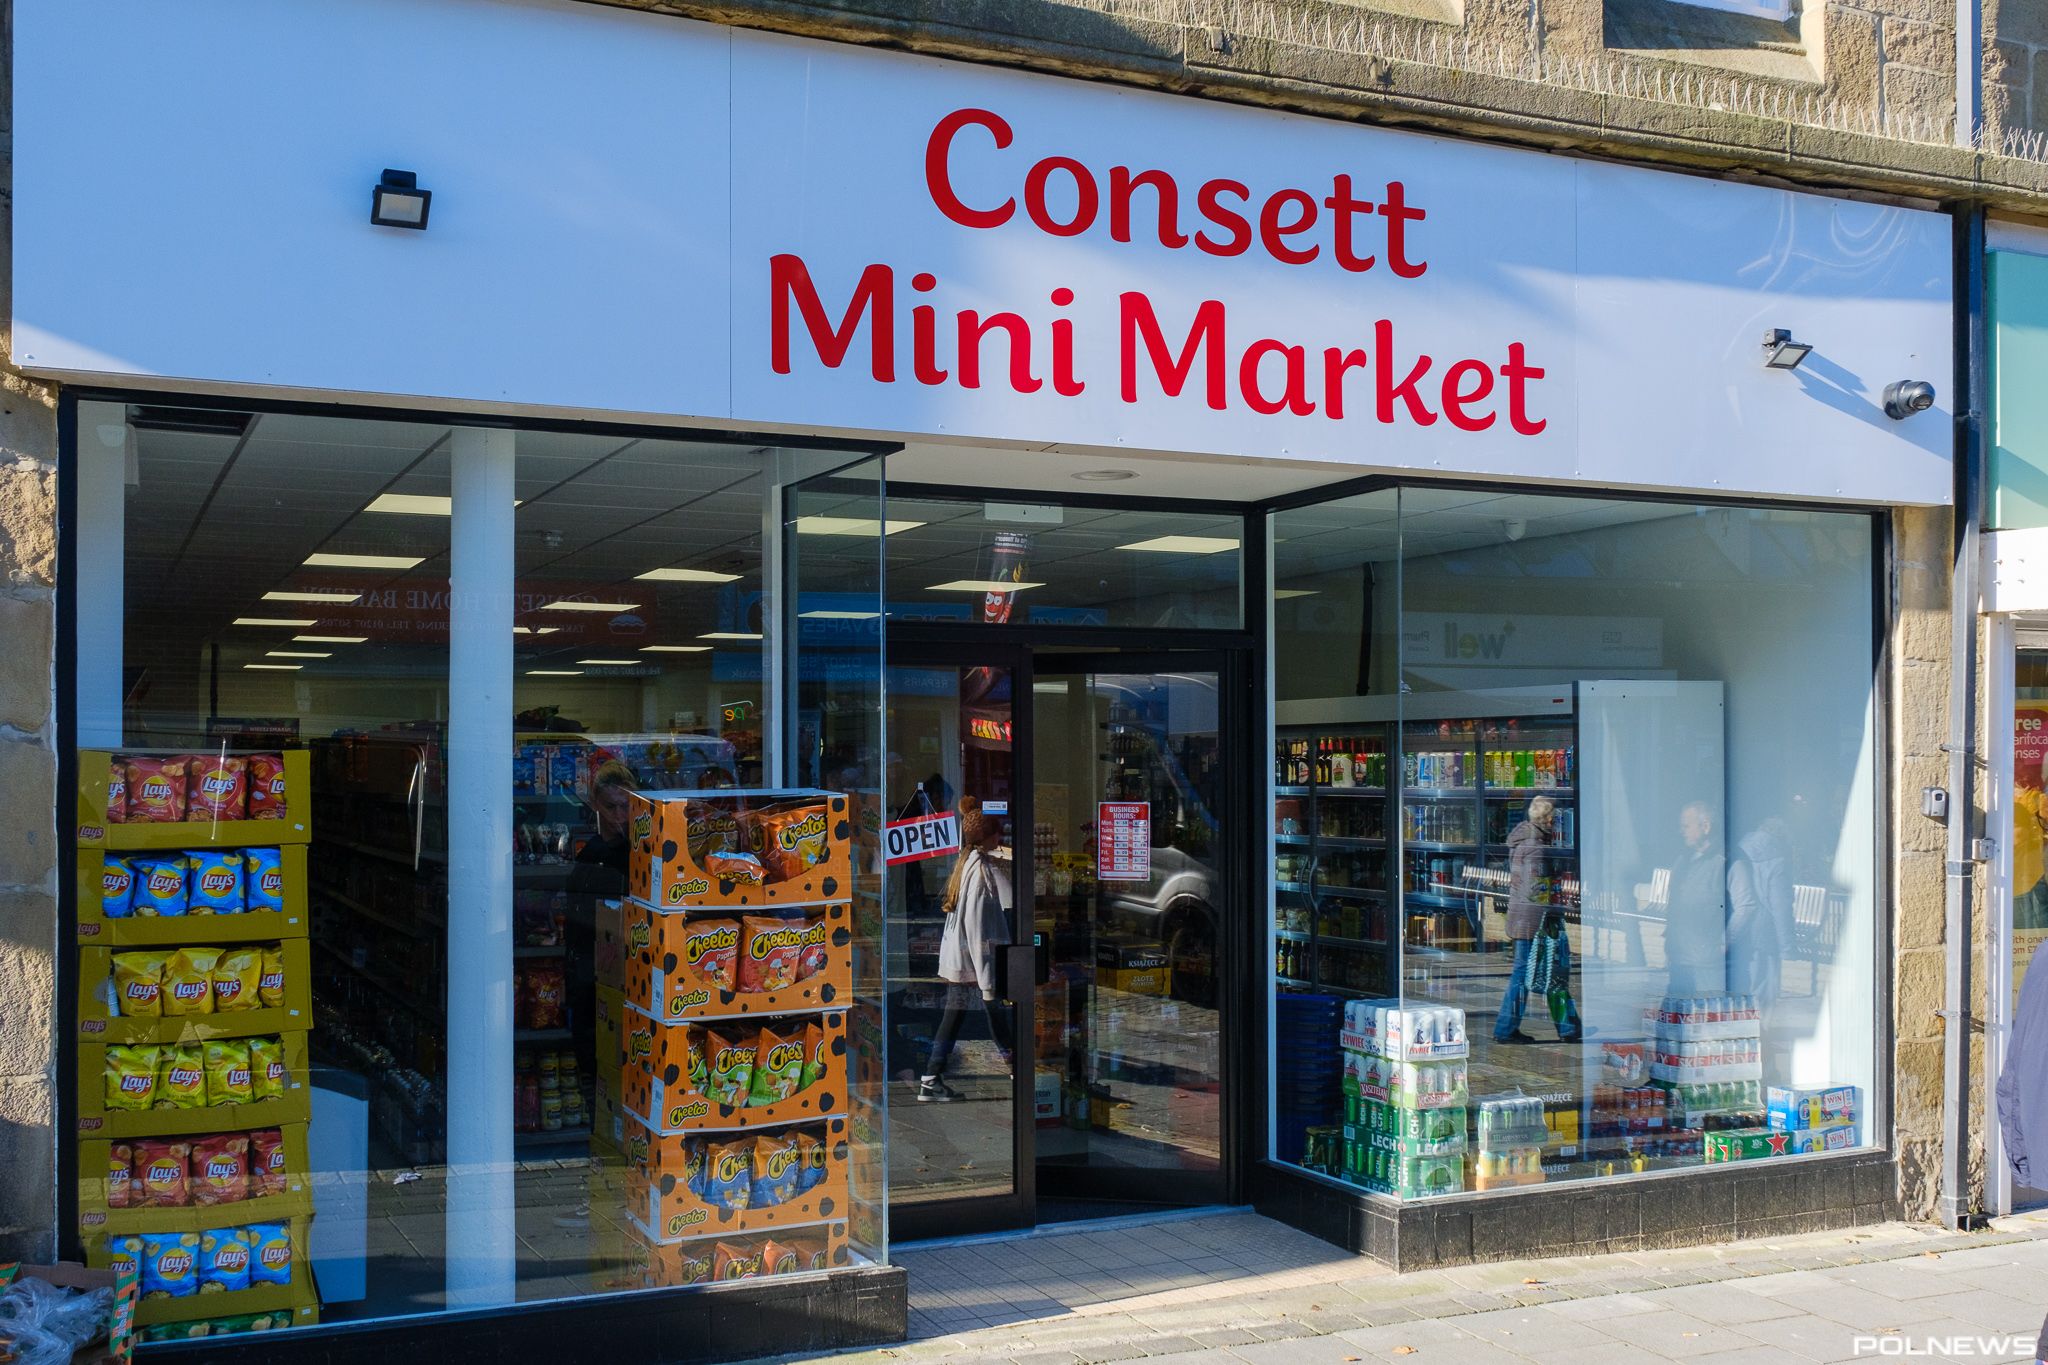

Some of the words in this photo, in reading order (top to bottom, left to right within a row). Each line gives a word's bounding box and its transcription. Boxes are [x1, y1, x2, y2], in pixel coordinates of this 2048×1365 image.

[925, 108, 1428, 279] Consett
[769, 253, 1085, 397] Mini
[1120, 291, 1547, 436] Market
[2015, 716, 2042, 731] ree
[2015, 748, 2041, 759] nses
[143, 783, 173, 799] Lay's
[203, 777, 236, 795] Lay's
[79, 826, 103, 839] Lay's
[779, 815, 827, 851] Cheetos
[887, 820, 951, 856] OPEN
[103, 874, 129, 891] ay's
[149, 874, 181, 892] Lay's
[202, 874, 234, 890] Lay's
[669, 880, 709, 903] Cheetos
[686, 928, 738, 964] Cheetos
[752, 928, 800, 960] Cheetos
[2013, 936, 2025, 945] ith
[127, 981, 159, 999] Lay's
[175, 981, 206, 999] Lay's
[670, 991, 710, 1015] Cheetos
[81, 1019, 106, 1033] Lay's
[169, 1067, 200, 1086] Lay's
[229, 1069, 250, 1086] Lay
[1826, 1094, 1842, 1104] WIN
[669, 1102, 709, 1127] Cheetos
[1371, 1133, 1396, 1152] LECH
[1829, 1133, 1844, 1143] WIN
[148, 1165, 181, 1183] Lay's
[206, 1163, 238, 1180] Lay's
[1542, 1164, 1570, 1174] SIĄŻĘCE
[669, 1210, 707, 1235] Cheetos
[160, 1255, 192, 1274] Lay's
[216, 1250, 248, 1269] Lay's
